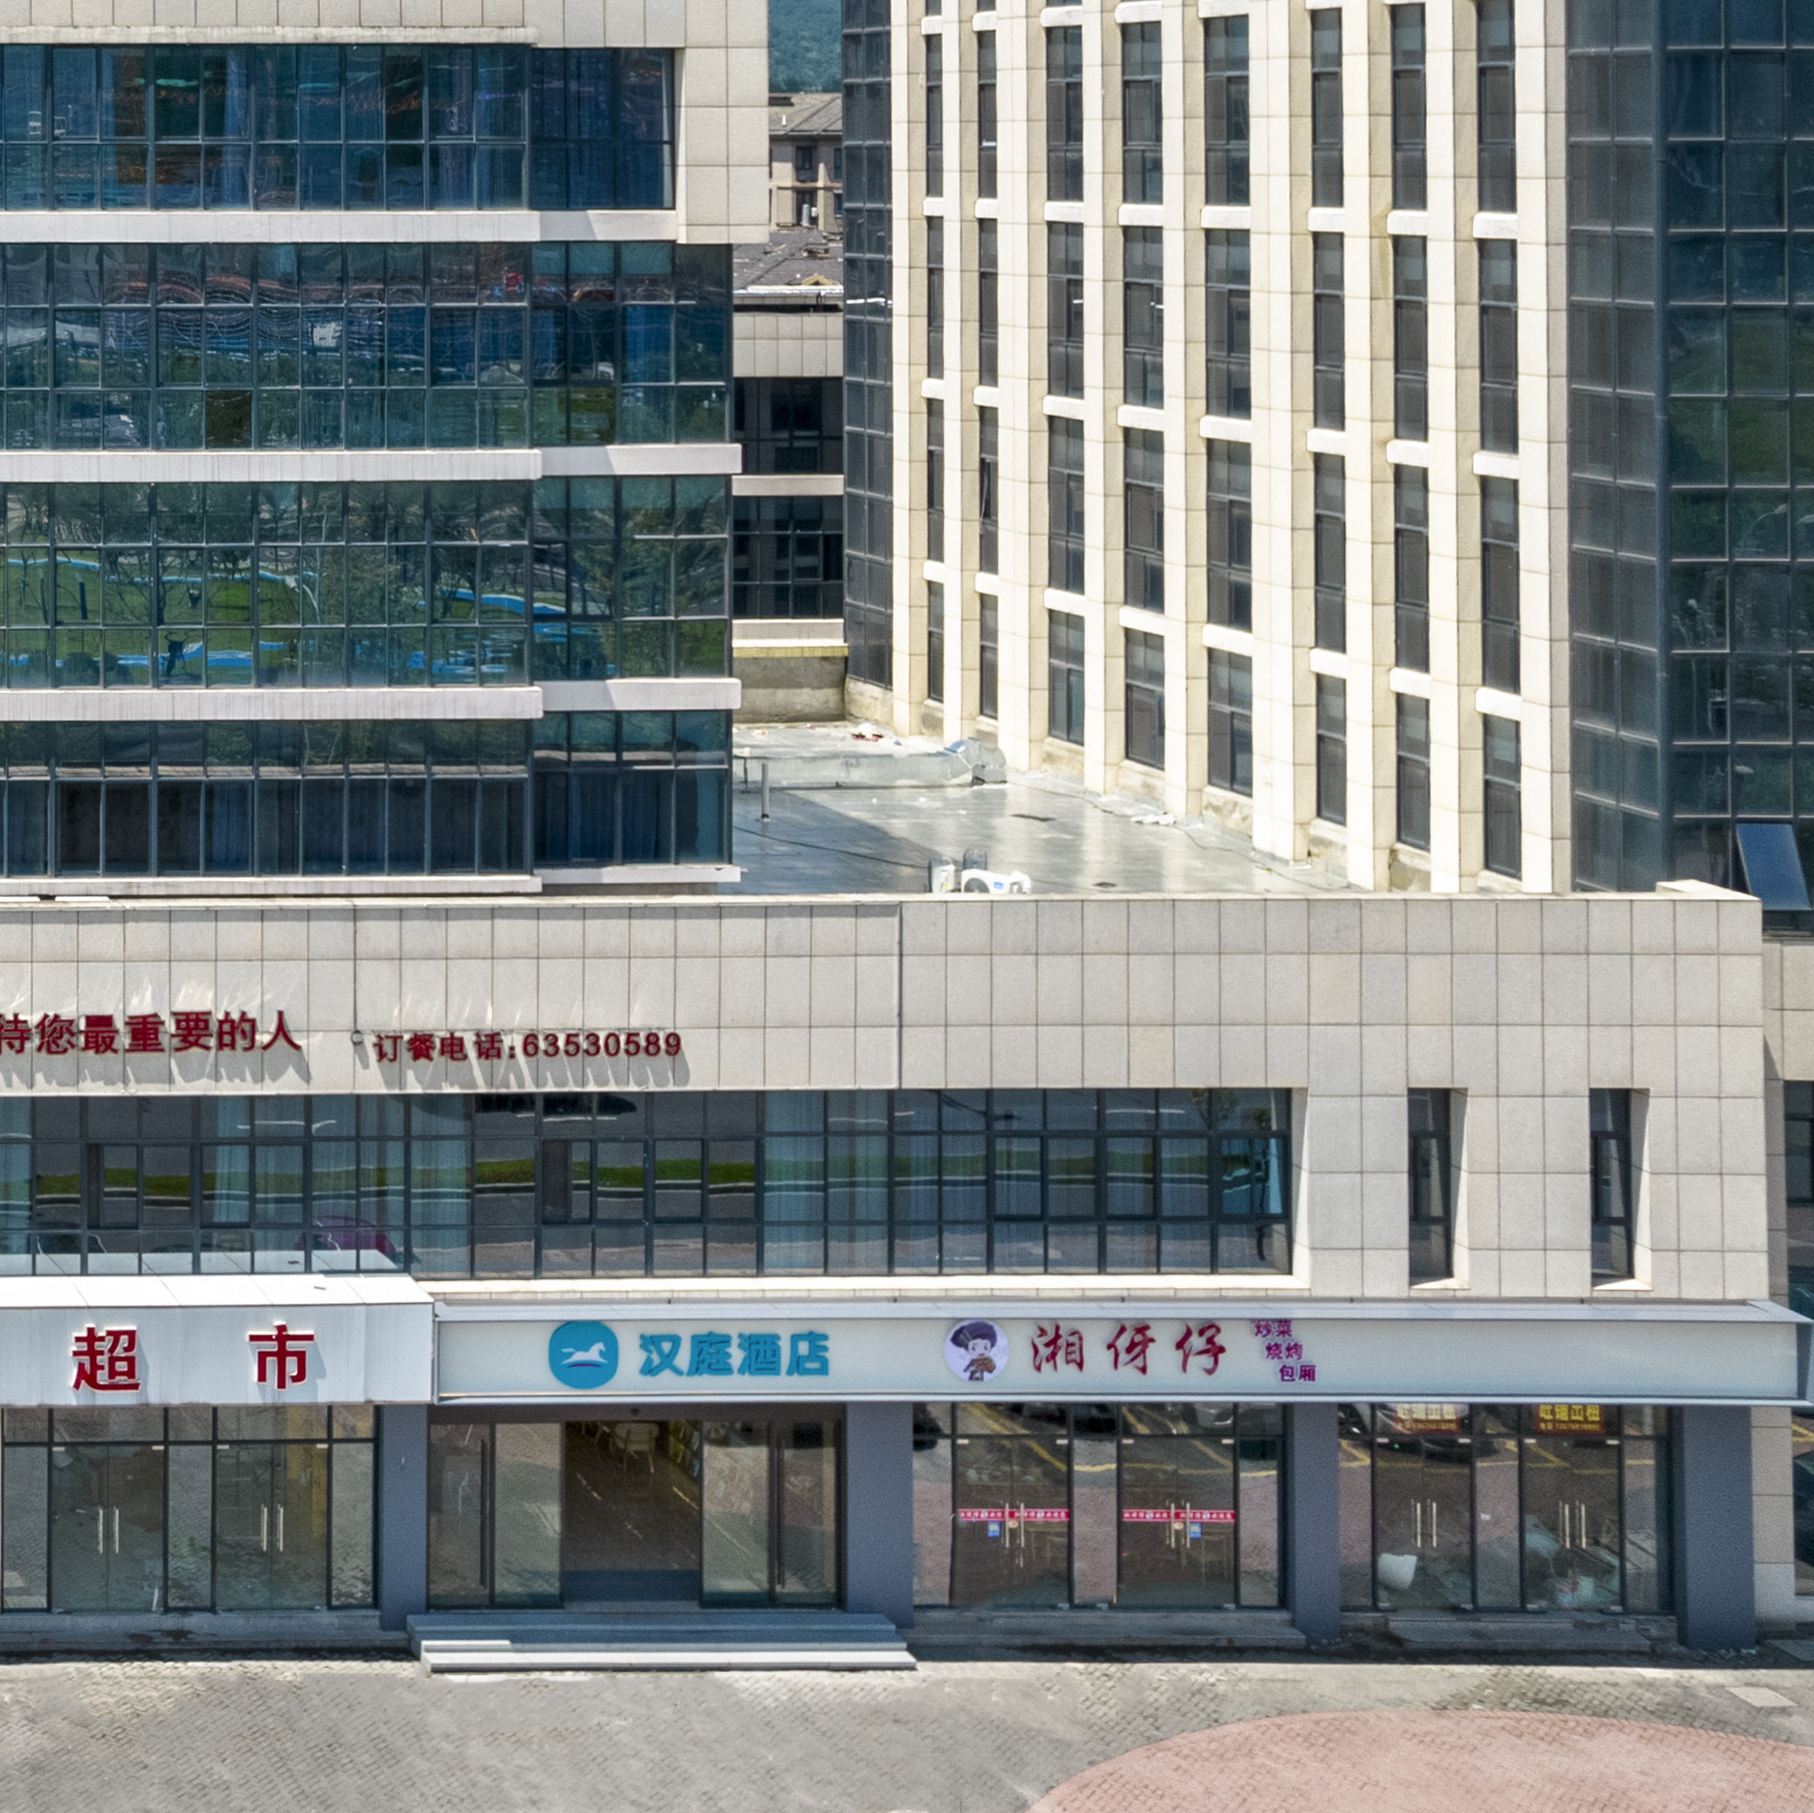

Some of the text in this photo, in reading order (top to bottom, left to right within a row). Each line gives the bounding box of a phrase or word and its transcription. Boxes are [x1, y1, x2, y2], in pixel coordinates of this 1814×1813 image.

[1254, 1319, 1293, 1338] 炒菜
[639, 1331, 830, 1377] 汉庭酒店
[1030, 1322, 1227, 1376] 湘伢仔
[1265, 1342, 1303, 1361] 烧烤
[1279, 1364, 1317, 1383] 包厢
